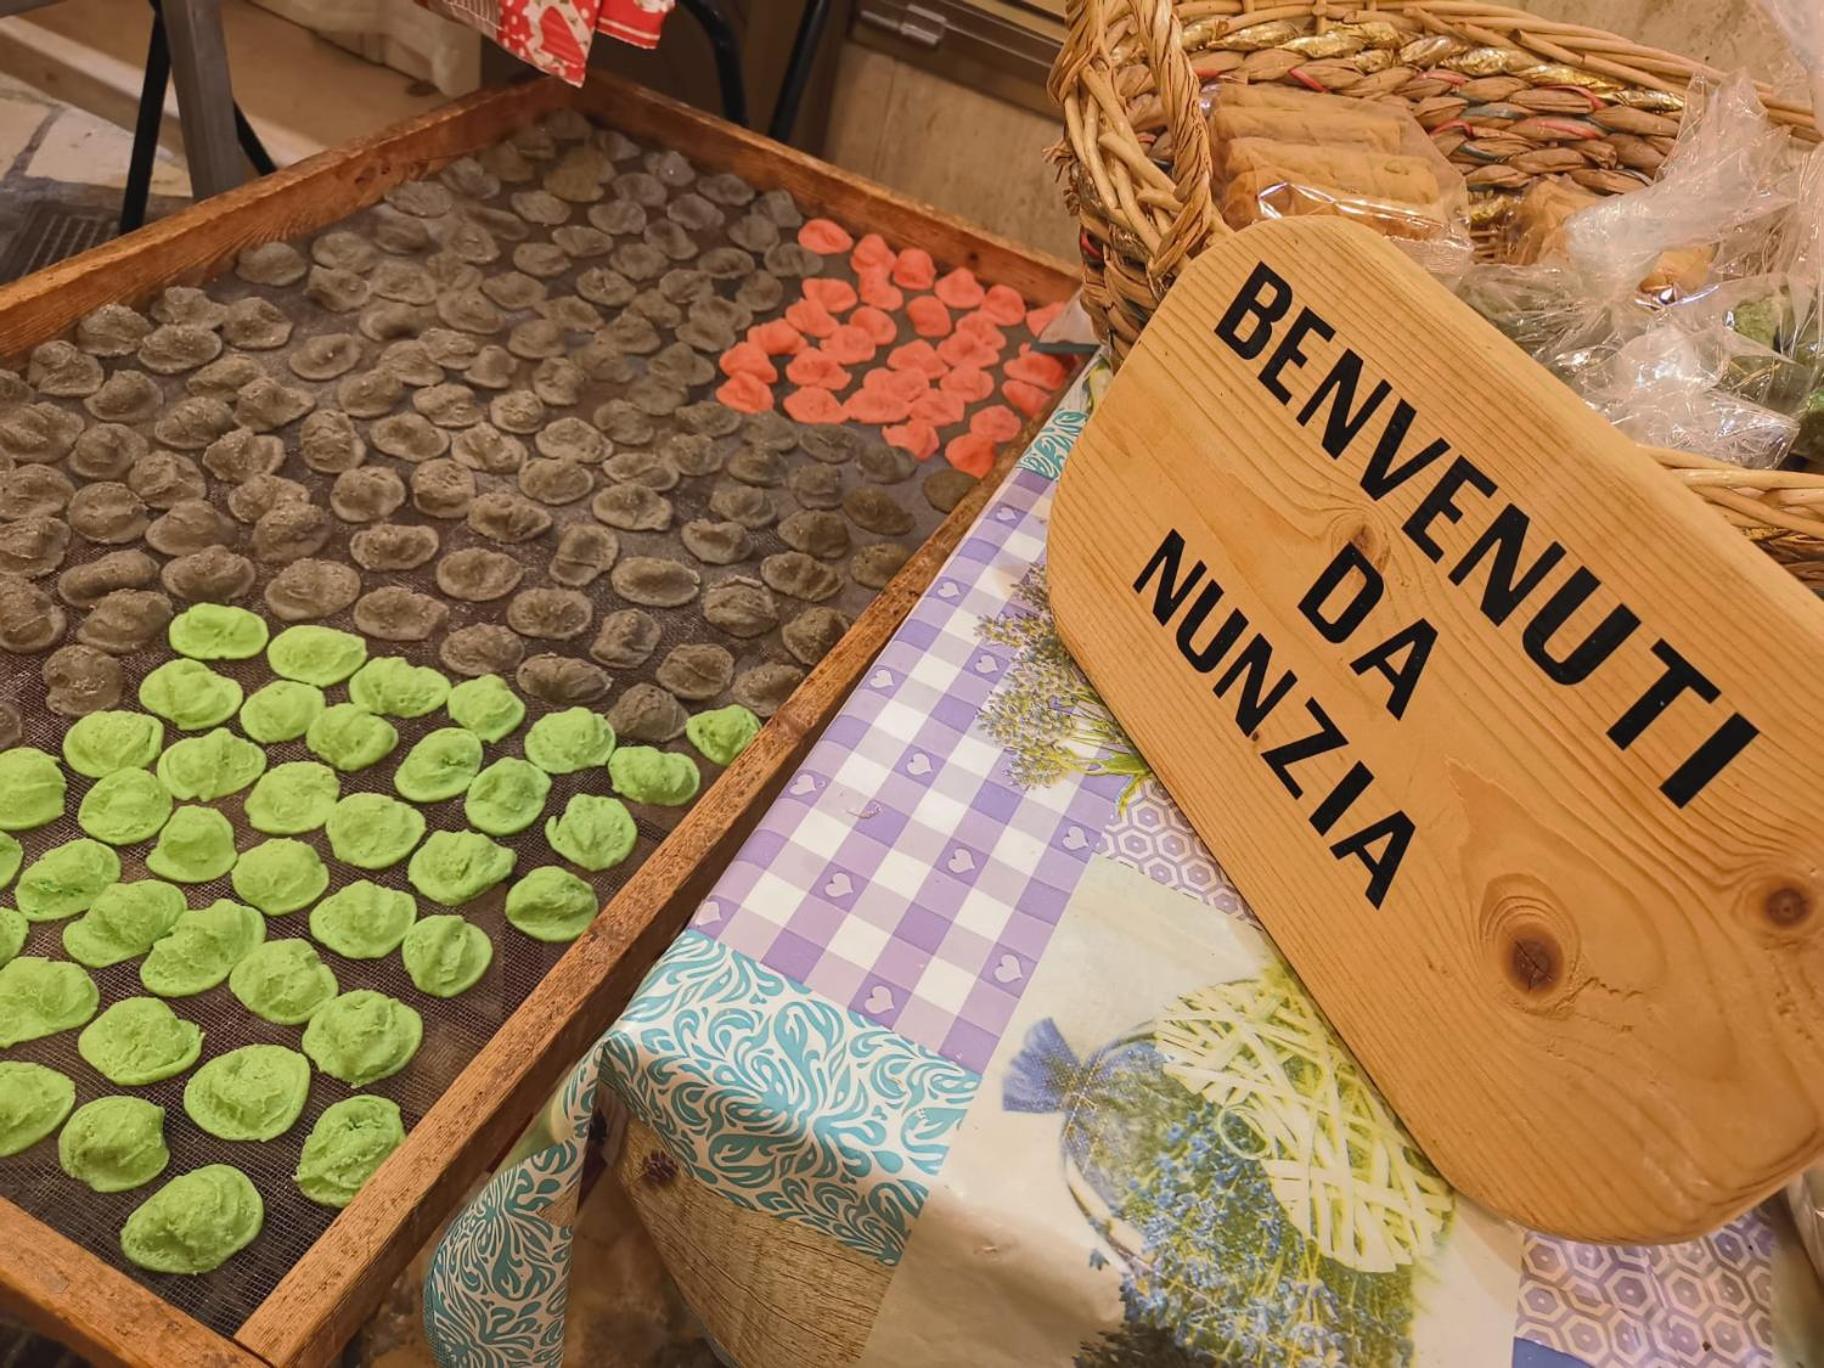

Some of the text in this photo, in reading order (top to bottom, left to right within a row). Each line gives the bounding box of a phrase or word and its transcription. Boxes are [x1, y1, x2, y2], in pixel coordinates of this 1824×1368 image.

[1133, 529, 1416, 909] NUNZIA
[1215, 262, 1760, 809] BENVENUTI
[1298, 542, 1438, 721] DA
